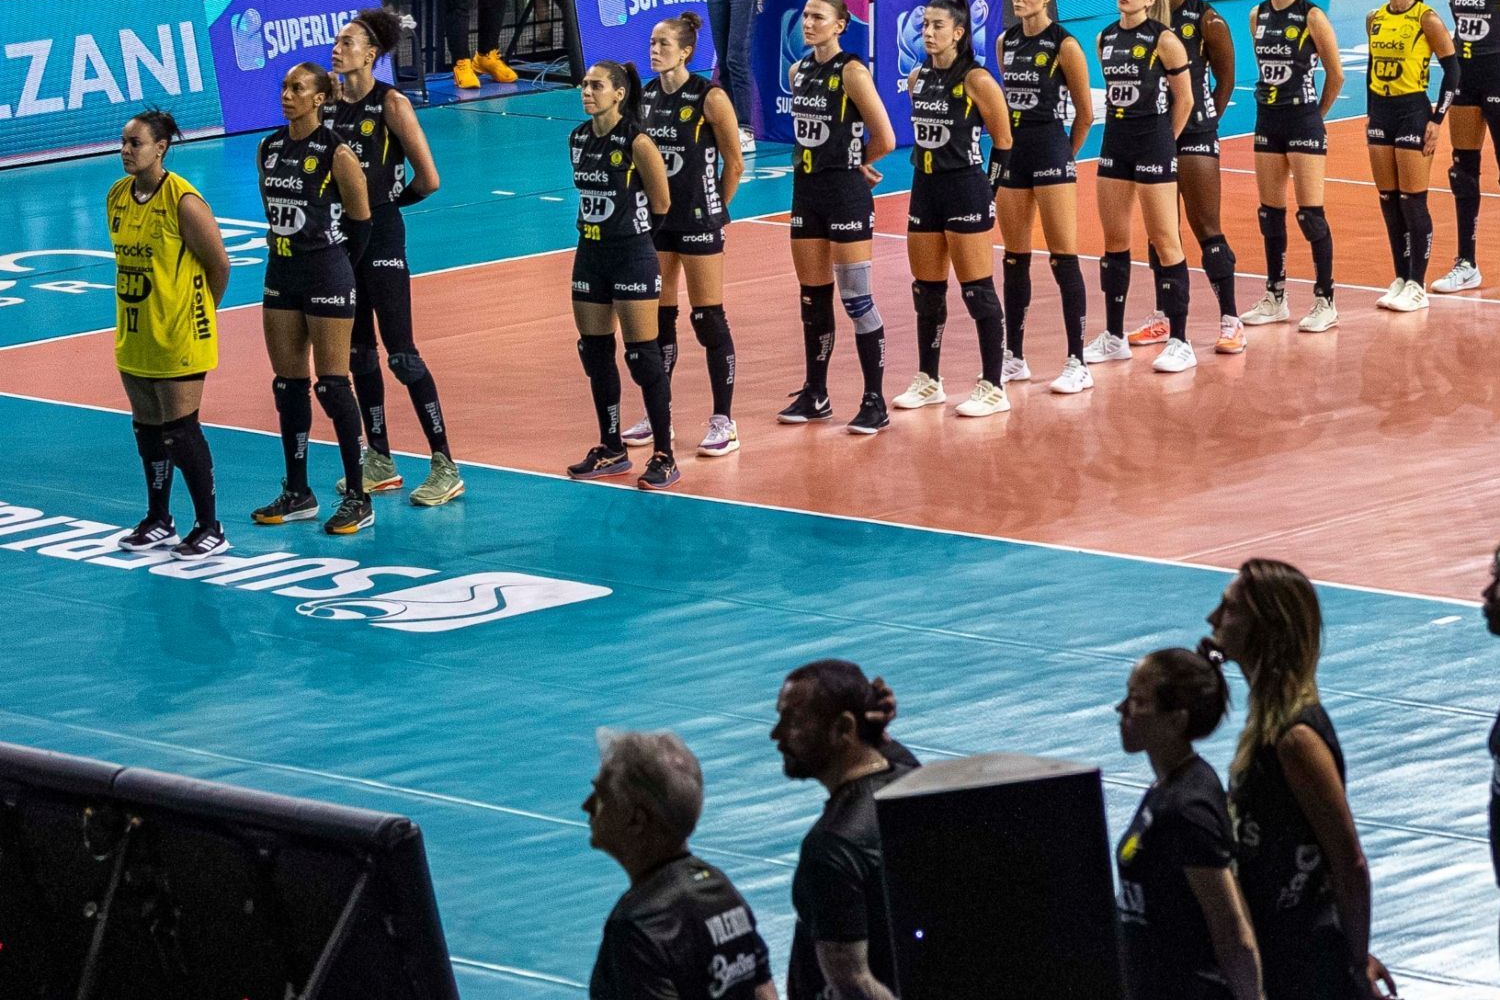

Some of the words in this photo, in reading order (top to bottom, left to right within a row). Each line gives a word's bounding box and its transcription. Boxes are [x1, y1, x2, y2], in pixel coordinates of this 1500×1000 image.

[263, 8, 360, 60] SUPERLI
[1459, 18, 1482, 36] BH
[1255, 43, 1292, 56] crock's
[1371, 40, 1405, 51] crock's
[1003, 70, 1040, 82] crock's
[1103, 62, 1140, 76] crock's
[1263, 66, 1287, 81] BH
[1376, 61, 1398, 78] BH
[794, 94, 828, 108] crock's
[1111, 86, 1133, 102] BH
[914, 100, 949, 112] crock's
[797, 120, 822, 142] BH
[916, 124, 943, 143] BH
[802, 148, 813, 174] 9
[265, 175, 304, 191] crock's
[574, 170, 609, 183] crock's
[705, 147, 723, 216] Dentil
[582, 196, 607, 216] BH
[269, 205, 298, 229] BH
[114, 242, 154, 259] crock's
[117, 272, 144, 297] BH
[193, 274, 212, 340] Dentil
[126, 306, 139, 334] 17
